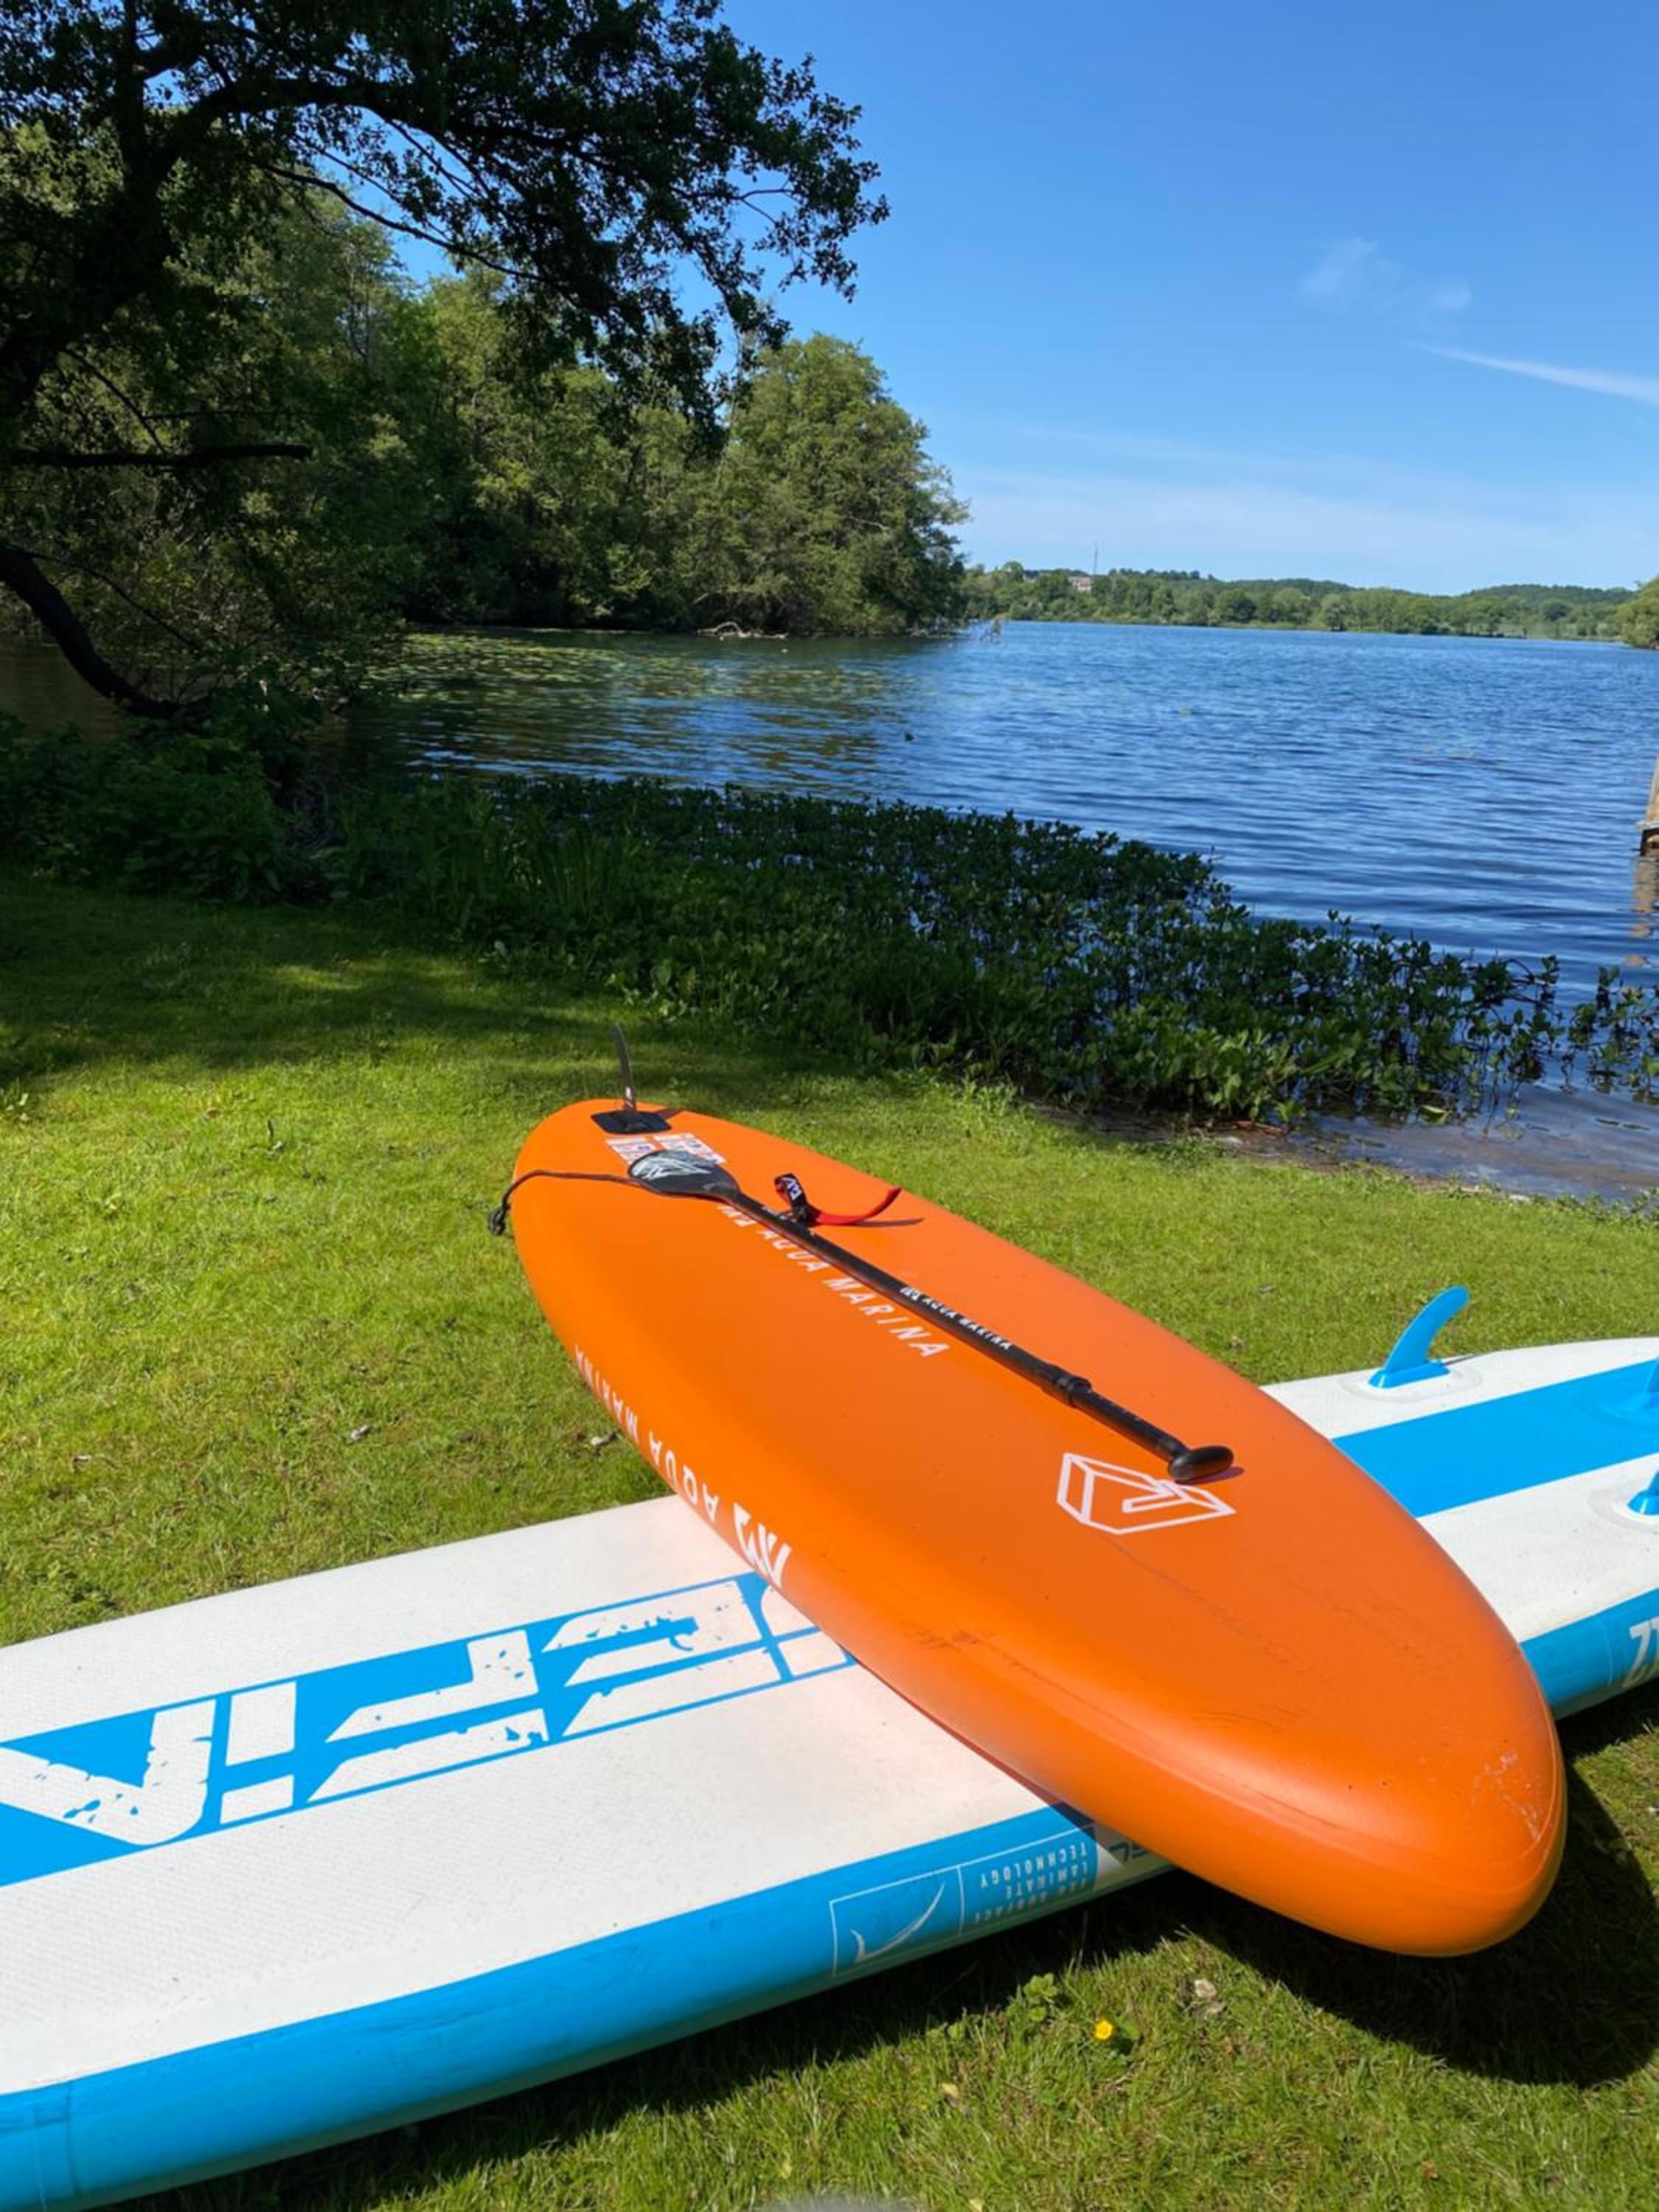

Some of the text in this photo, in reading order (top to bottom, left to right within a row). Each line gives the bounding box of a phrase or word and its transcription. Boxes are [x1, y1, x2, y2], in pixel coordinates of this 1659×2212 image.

[755, 1228, 950, 1357] AQUA MARINA
[922, 1295, 1014, 1351] AQUA MARINA
[574, 1342, 719, 1523] AQUA MARINA
[979, 1841, 1088, 1889] TECHNOLOGY
